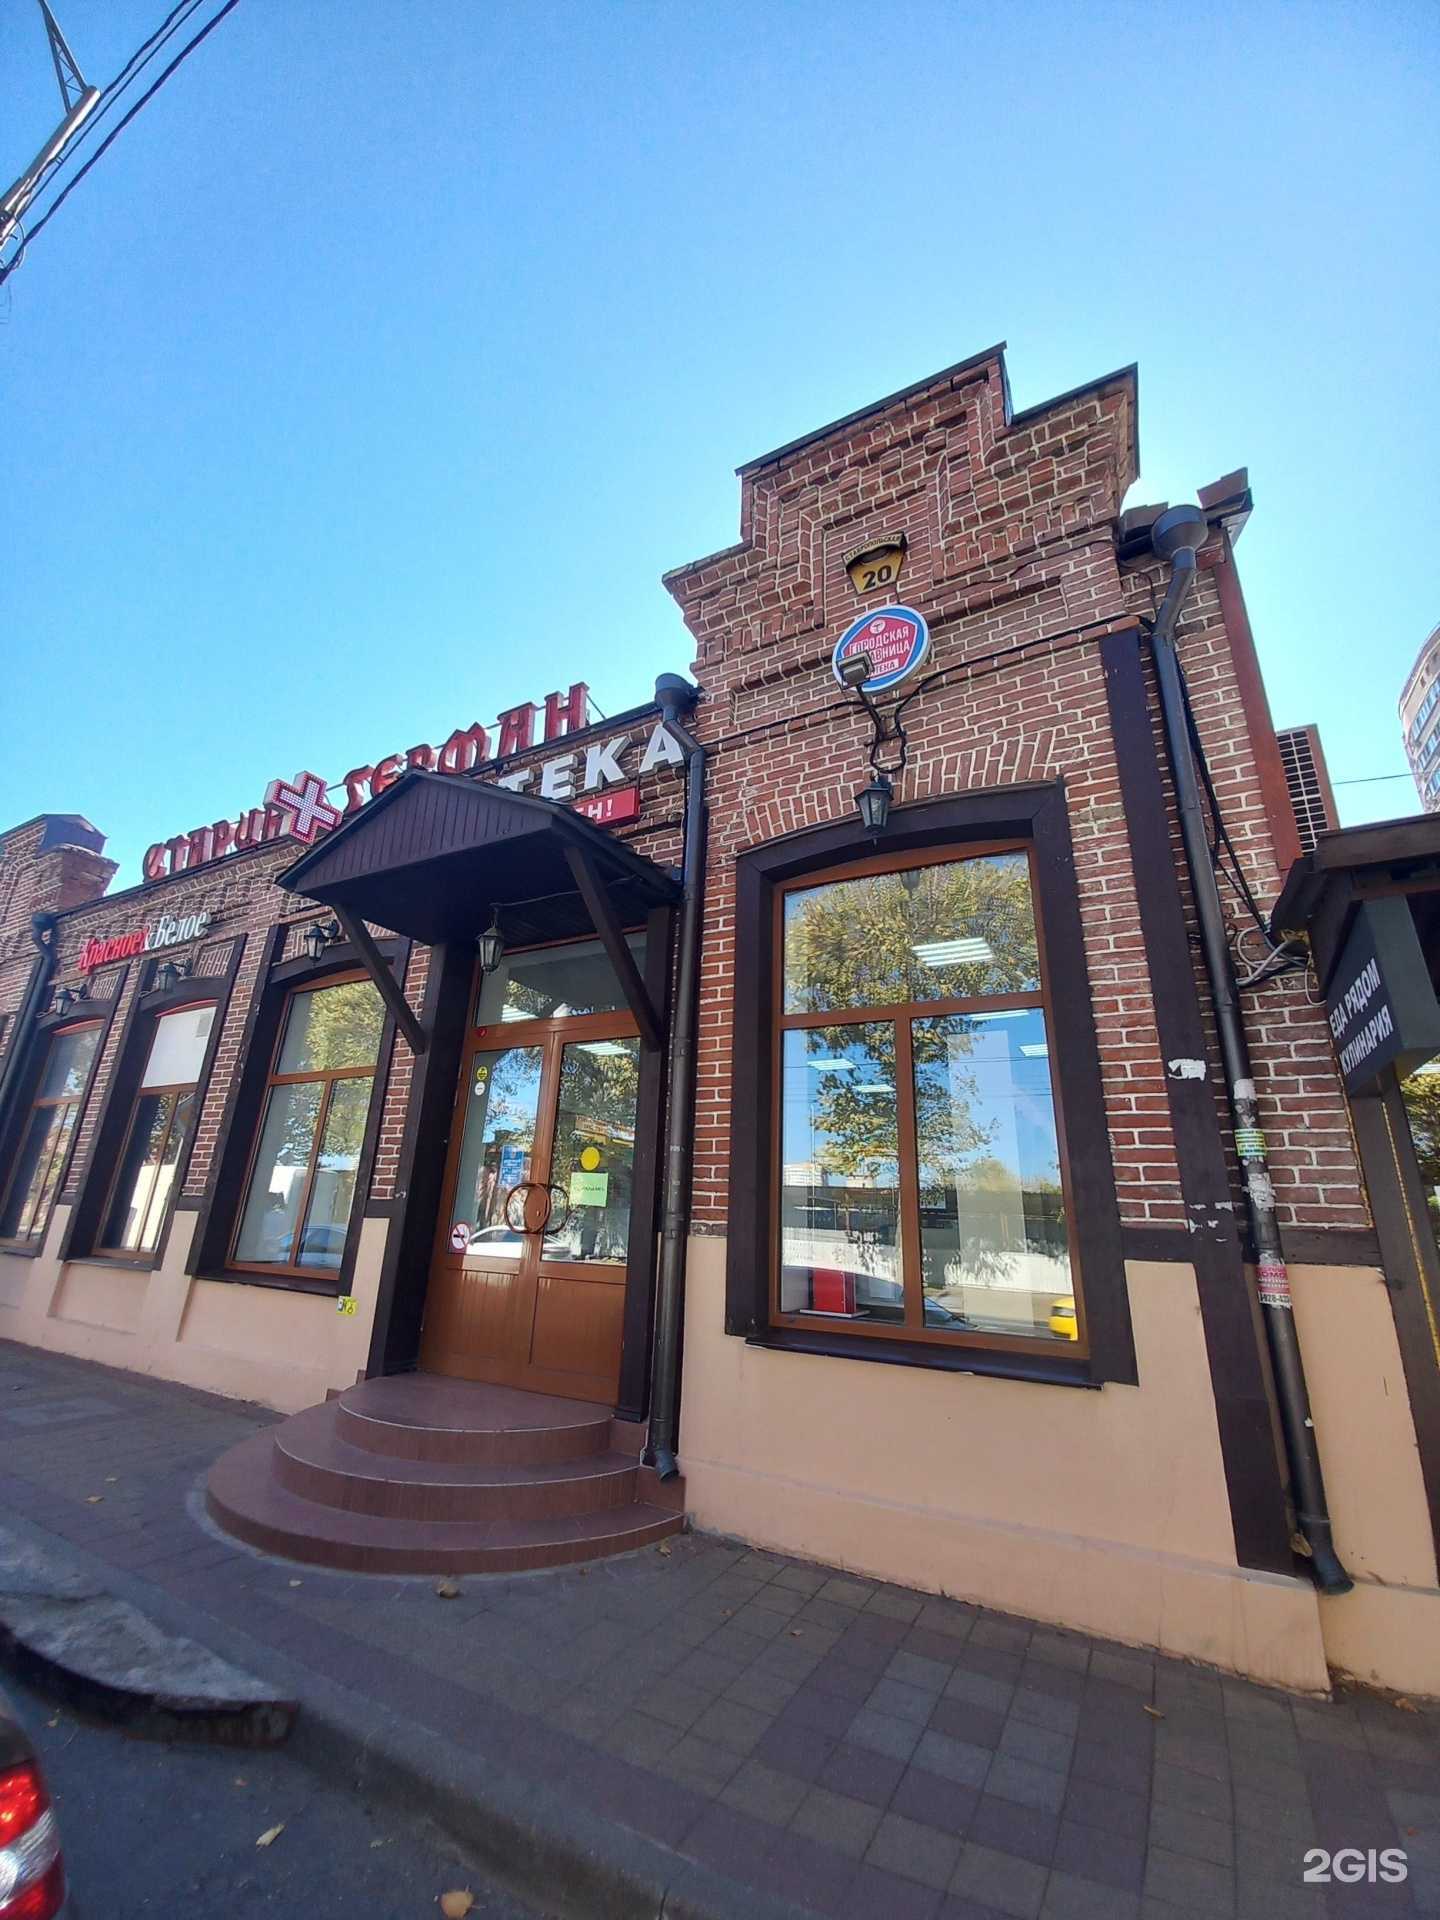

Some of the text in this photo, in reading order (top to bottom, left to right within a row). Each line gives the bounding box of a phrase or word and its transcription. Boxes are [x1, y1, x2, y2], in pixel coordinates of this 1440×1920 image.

[862, 565, 892, 591] 20
[1329, 957, 1381, 1039] ЕДА РЯДОМ
[1339, 1004, 1394, 1075] КУЛИНАРИЯ
